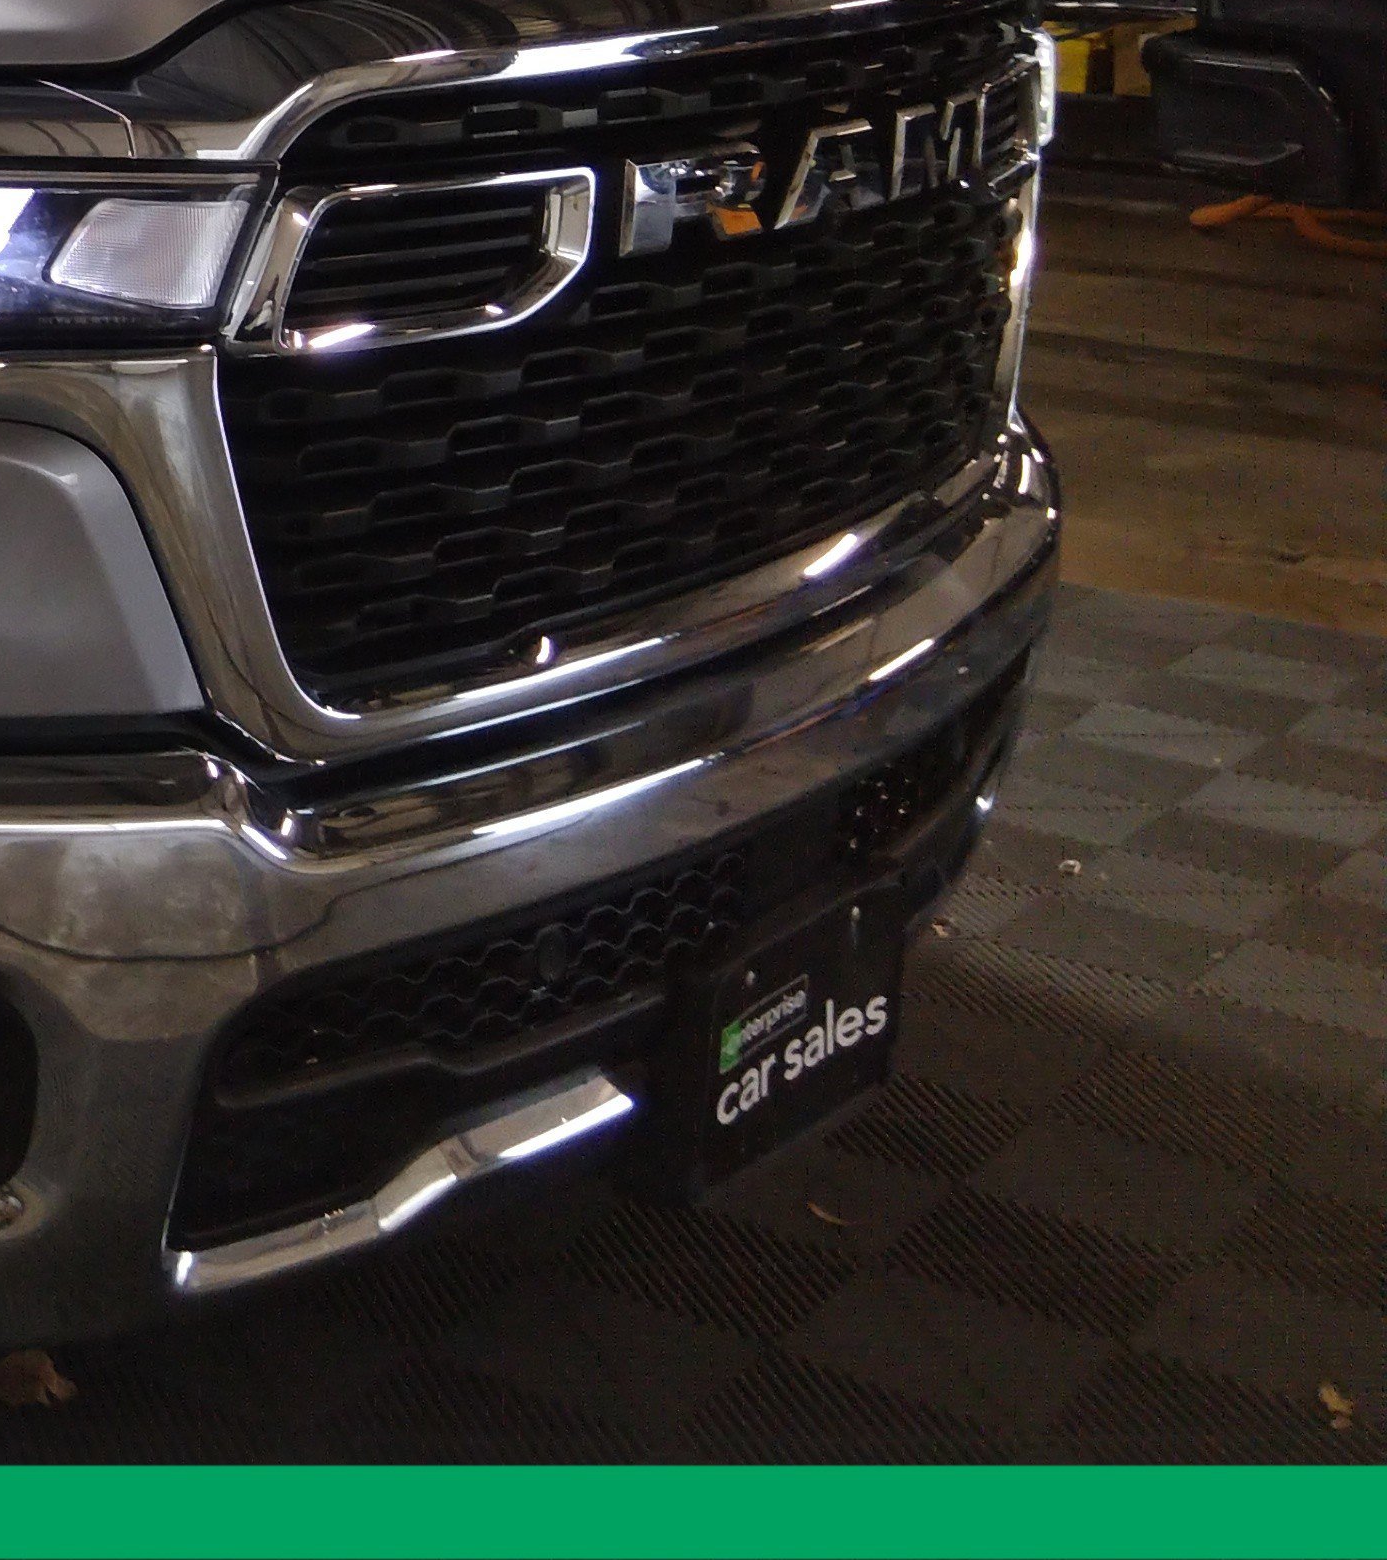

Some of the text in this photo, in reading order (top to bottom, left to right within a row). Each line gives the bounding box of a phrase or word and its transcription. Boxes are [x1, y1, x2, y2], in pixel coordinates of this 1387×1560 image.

[618, 84, 981, 258] RAM
[716, 994, 888, 1125] car sales
